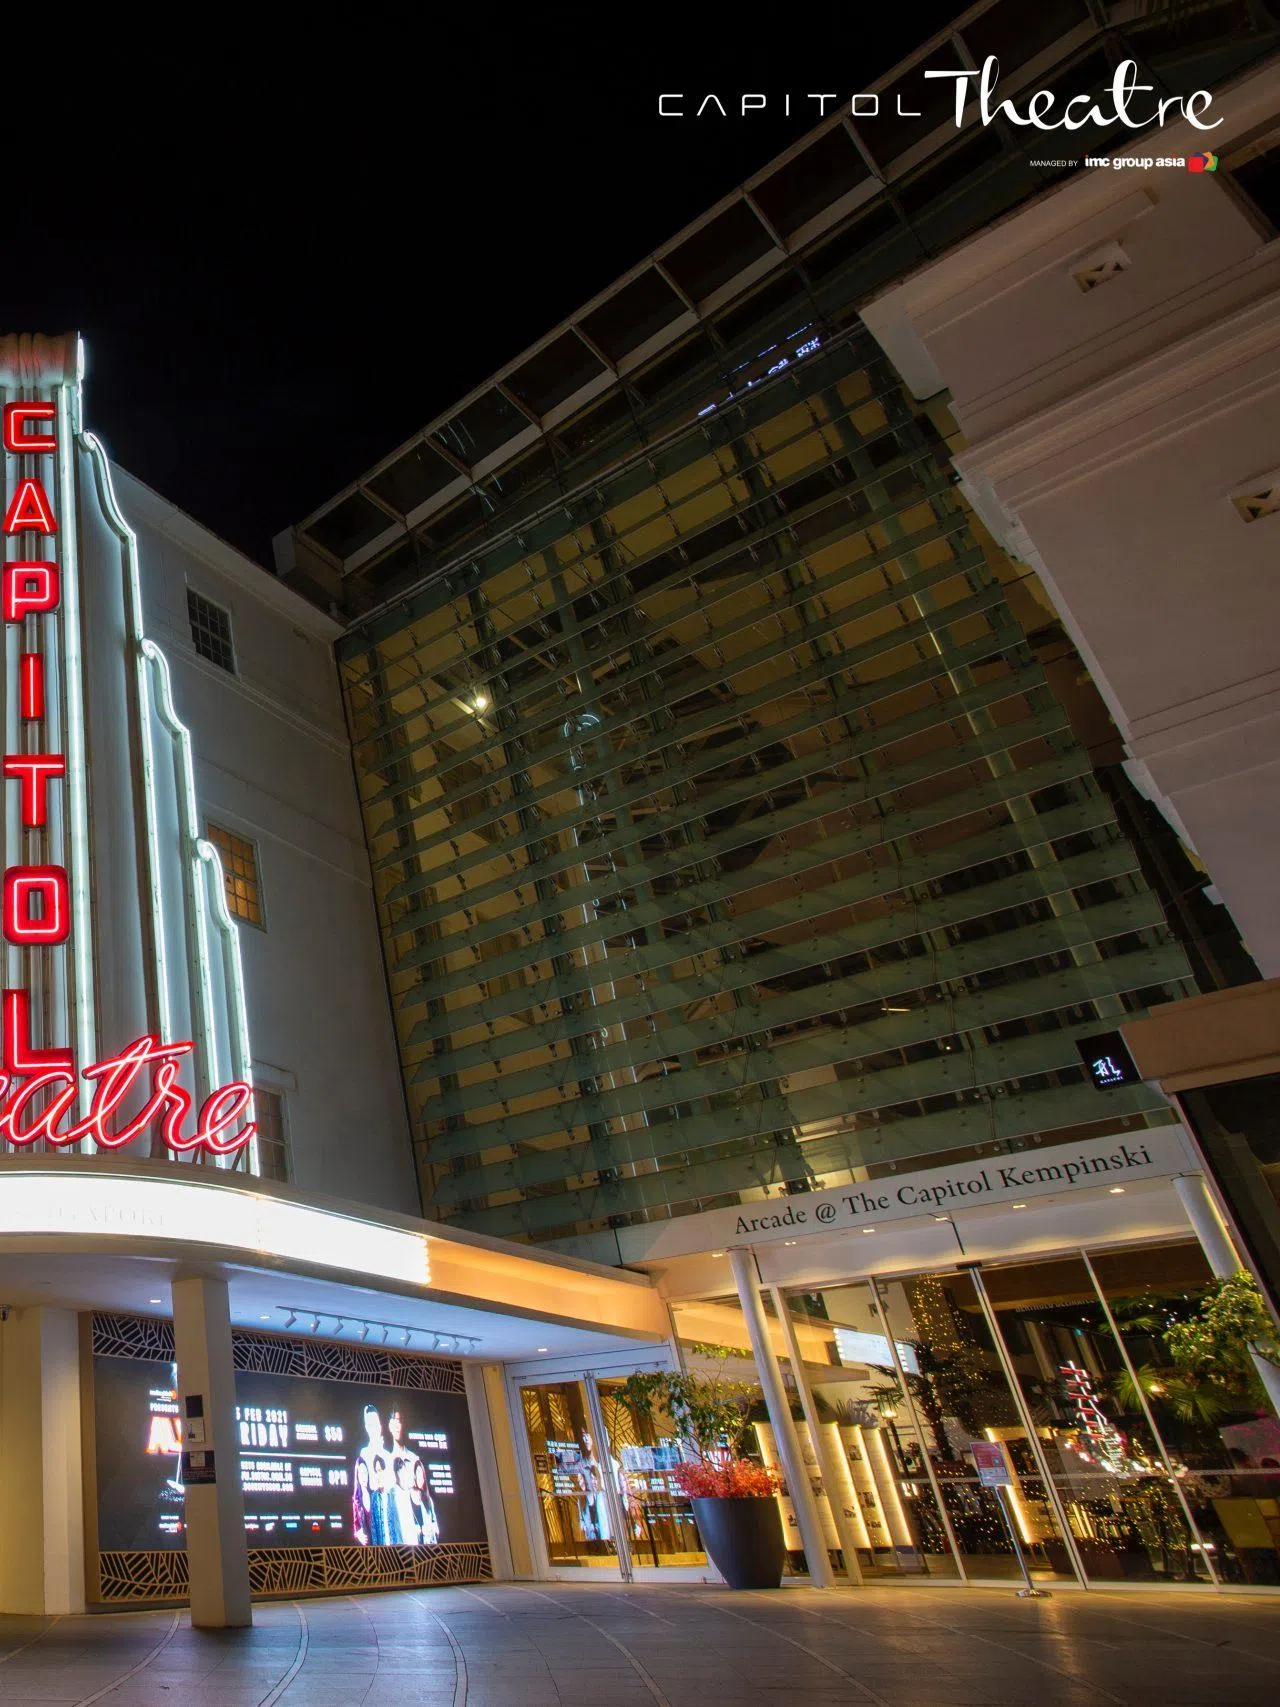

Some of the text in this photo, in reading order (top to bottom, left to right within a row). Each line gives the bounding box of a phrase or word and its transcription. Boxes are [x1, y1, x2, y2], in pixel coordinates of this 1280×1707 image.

[3, 401, 72, 1077] CAPITOL
[735, 1144, 1153, 1235] Arcade @ The Capitol Kempinski
[239, 1421, 288, 1448] RIDAY
[244, 1407, 262, 1422] FEB
[265, 1409, 287, 1424] 2021
